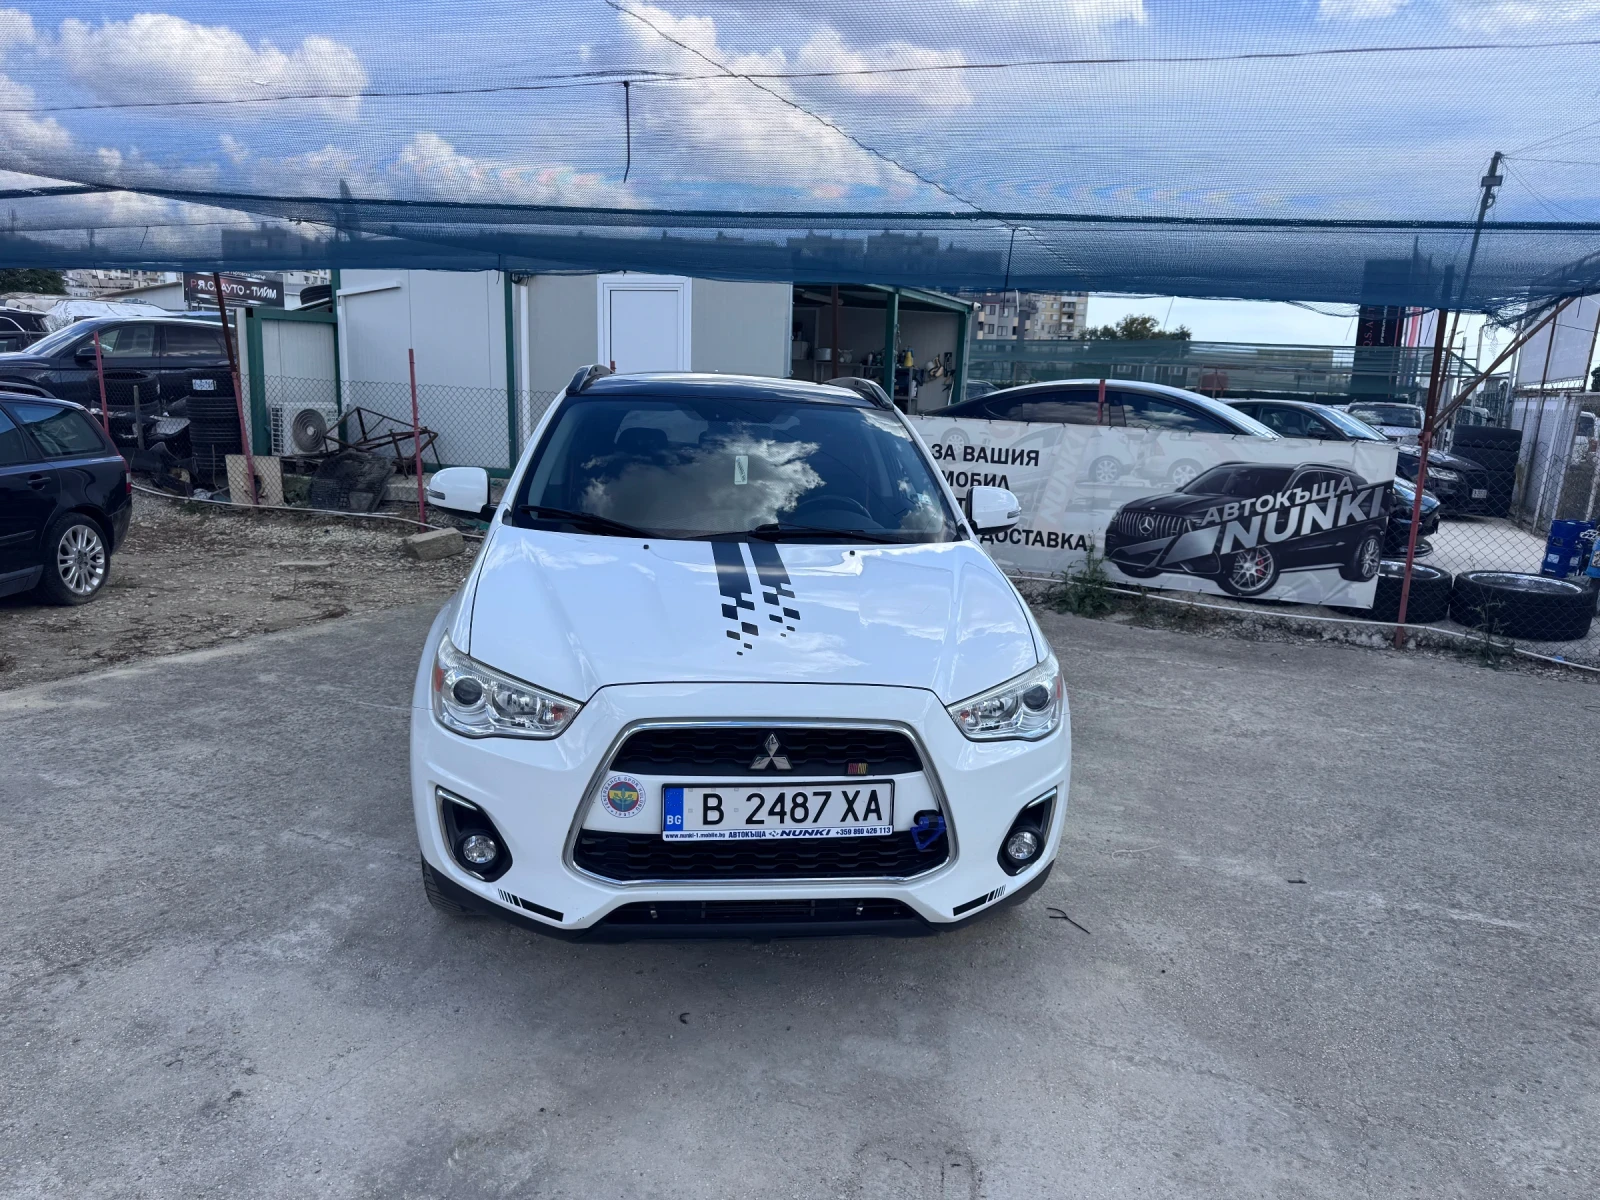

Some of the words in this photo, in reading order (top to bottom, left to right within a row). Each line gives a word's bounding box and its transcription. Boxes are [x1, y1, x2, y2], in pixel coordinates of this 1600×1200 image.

[220, 283, 245, 296] АУТО
[251, 286, 277, 300] ТИЙМ
[931, 443, 956, 461] ЗА
[963, 445, 1040, 467] ВАШИЯ
[1201, 476, 1354, 526] АВТОКЪЩА
[1220, 486, 1385, 555] NUNKI
[702, 793, 724, 826] B
[745, 791, 832, 825] 2487
[840, 789, 883, 823] XA
[667, 815, 682, 825] BG
[728, 830, 767, 839] АВТОКЪЩА
[779, 828, 832, 837] NUNKI
[835, 828, 852, 836] +359
